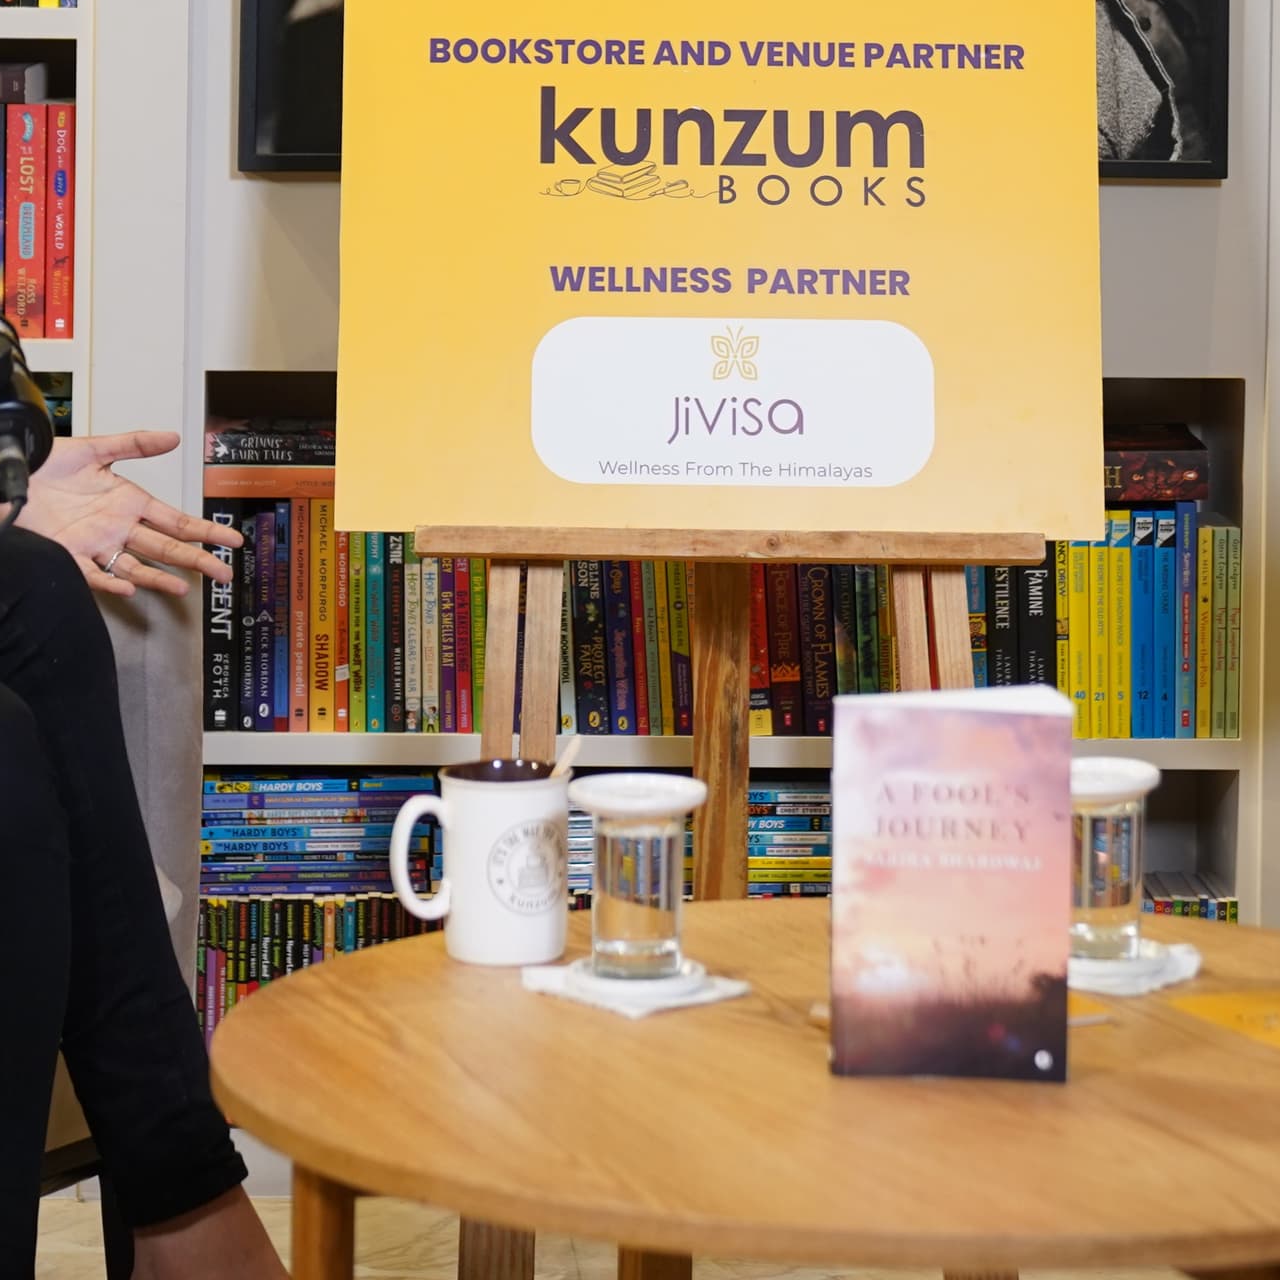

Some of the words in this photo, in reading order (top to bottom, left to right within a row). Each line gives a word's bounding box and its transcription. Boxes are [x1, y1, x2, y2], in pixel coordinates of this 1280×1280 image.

[429, 38, 645, 66] BOOKSTORE
[653, 40, 731, 66] AND
[739, 41, 856, 68] VENUE
[864, 42, 1025, 70] PARTNER
[539, 86, 926, 169] kunzum
[20, 156, 35, 194] LOST
[719, 175, 926, 208] BOOKS
[550, 266, 732, 294] WELLNESS
[747, 268, 910, 296] PARTNER
[599, 461, 679, 476] Wellness
[685, 462, 733, 476] From
[739, 462, 773, 477] The
[778, 463, 873, 481] Himalayas
[319, 504, 327, 555] MICHAEL
[318, 558, 327, 622] MORPURGO
[1024, 569, 1048, 616] FAMINE
[260, 627, 269, 649] RICK
[295, 611, 305, 648] private
[213, 654, 222, 698] ROTH
[260, 653, 268, 697] RIORDAN
[295, 652, 304, 697] peaceful
[315, 634, 328, 691] SHADOW
[258, 783, 295, 791] HARDY
[296, 782, 323, 791] BOYS
[872, 816, 1030, 841] JOURNEY
